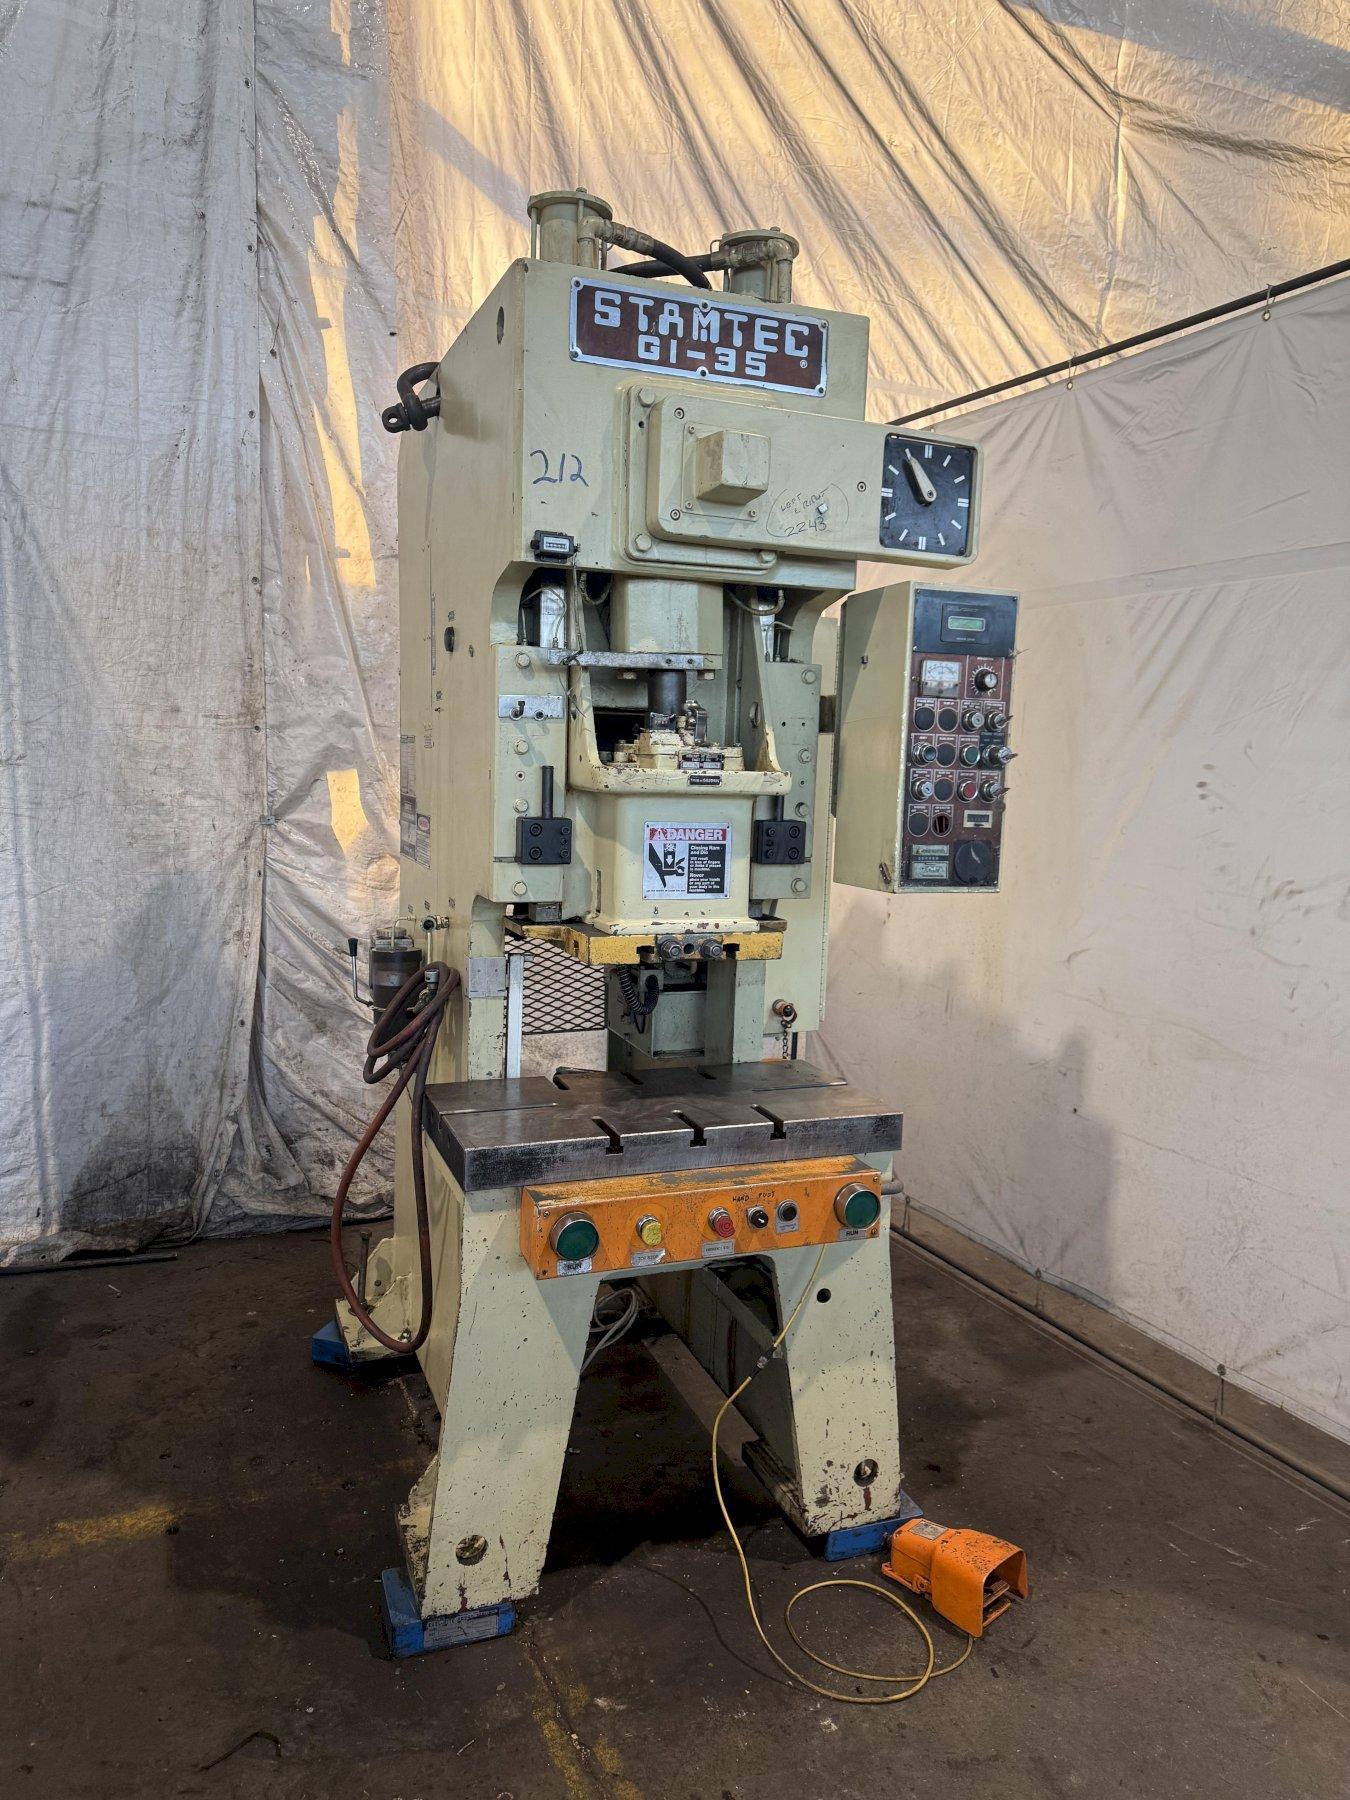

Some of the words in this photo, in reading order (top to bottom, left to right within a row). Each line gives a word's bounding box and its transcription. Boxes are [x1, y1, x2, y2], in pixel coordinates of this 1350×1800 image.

[594, 290, 810, 358] STAMTEC
[637, 334, 767, 377] GI-35
[530, 449, 589, 487] 212
[785, 516, 827, 537] 2243
[667, 828, 723, 841] DANGER
